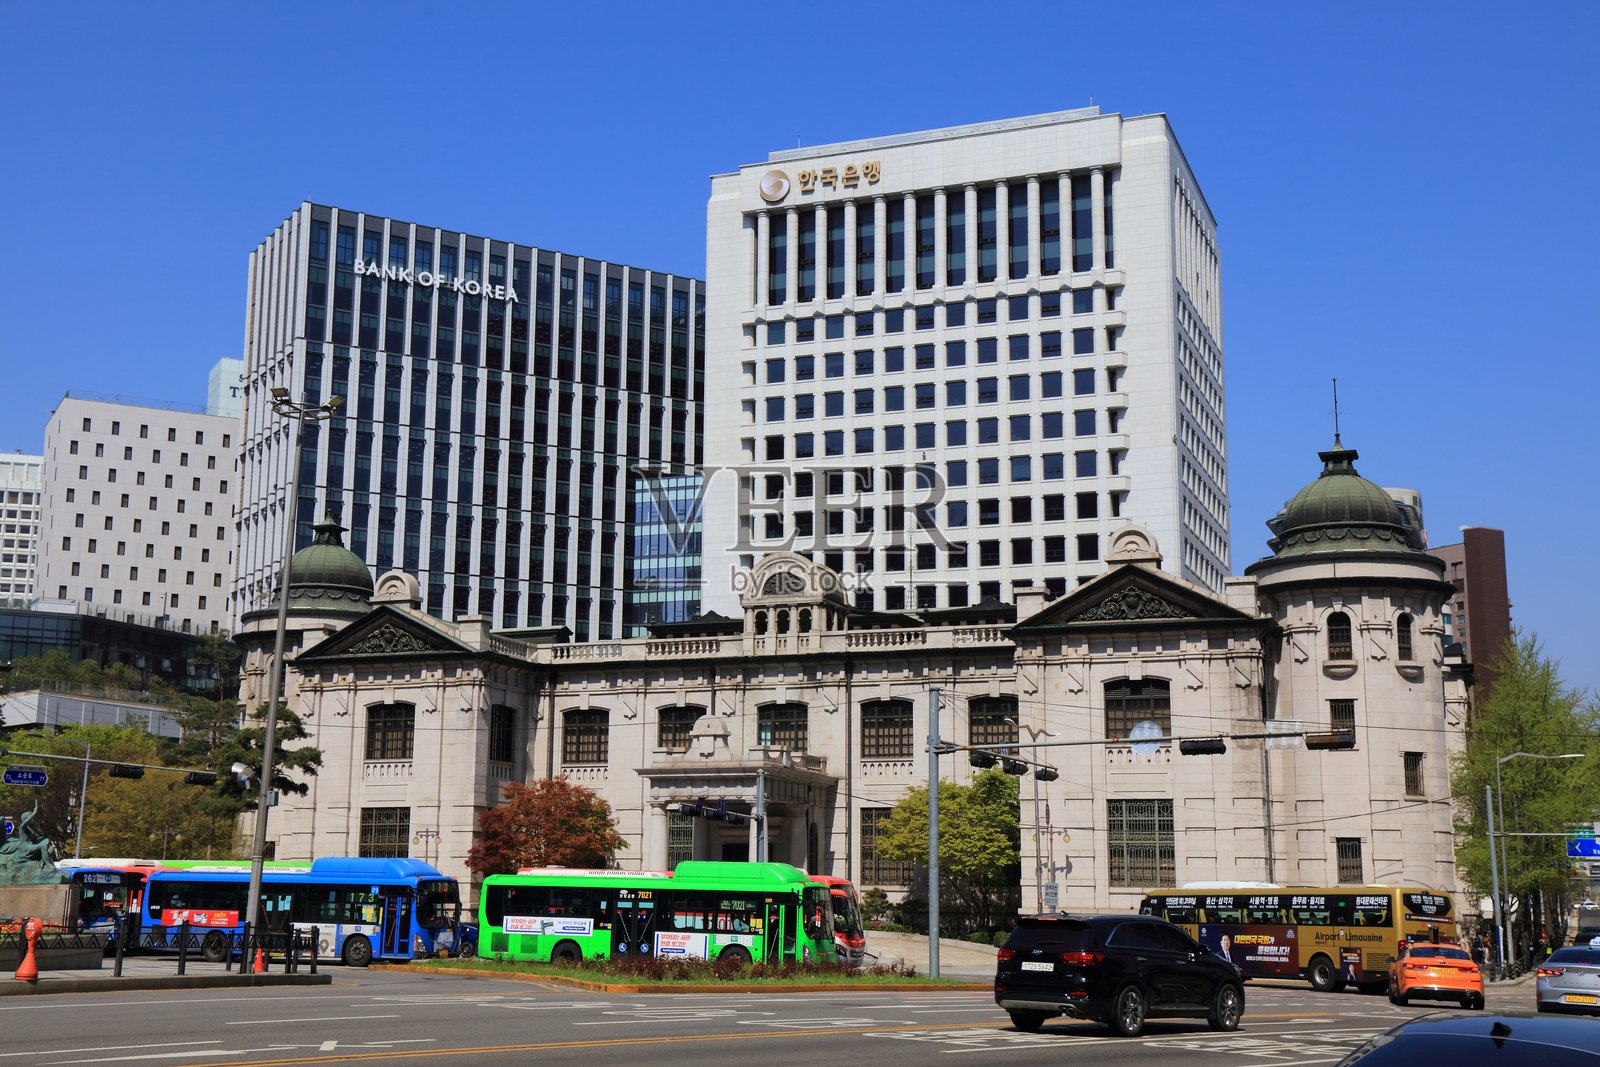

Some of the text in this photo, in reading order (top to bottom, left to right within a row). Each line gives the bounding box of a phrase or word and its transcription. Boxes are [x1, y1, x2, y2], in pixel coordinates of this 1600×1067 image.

[798, 161, 880, 192] 한국은행
[354, 258, 519, 303] BANK OF KOREA
[84, 874, 97, 883] 262
[351, 892, 375, 903] 173
[637, 891, 652, 899] 7021
[731, 900, 745, 910] 7021
[1315, 932, 1383, 942] Airport Limousine
